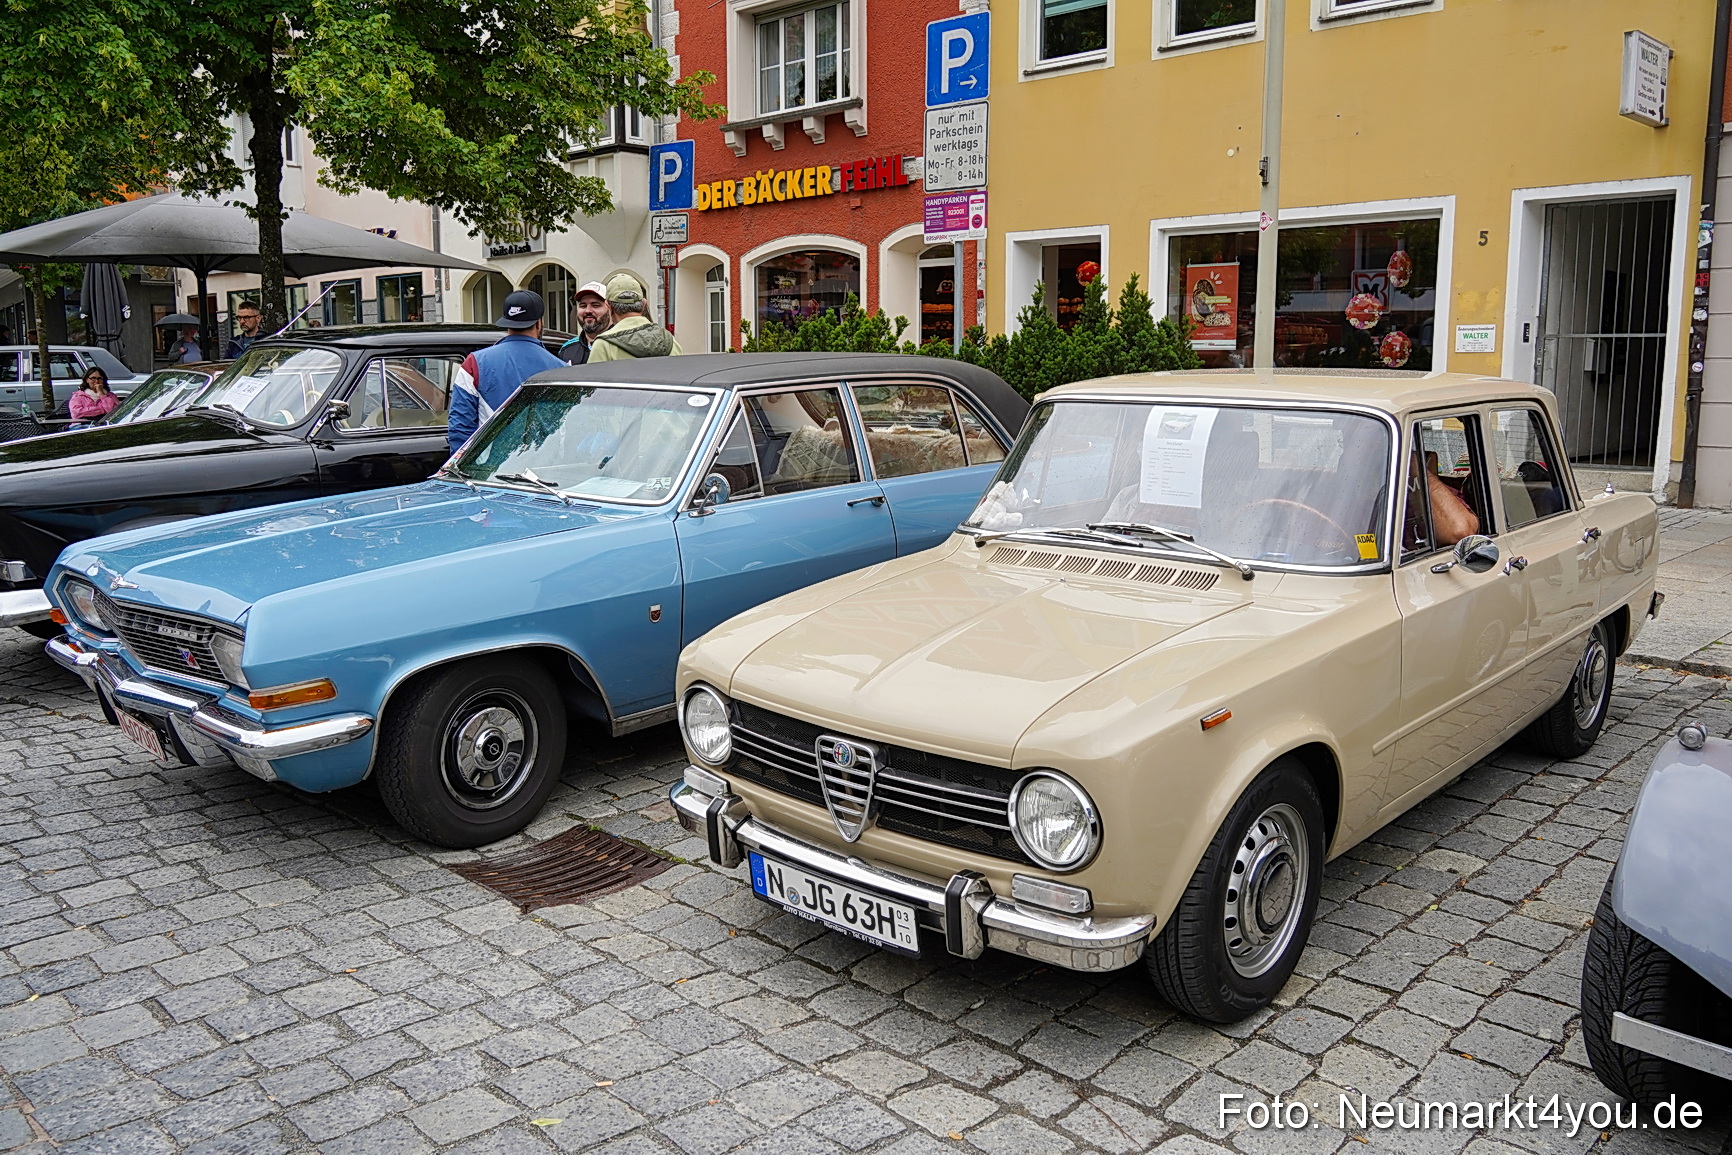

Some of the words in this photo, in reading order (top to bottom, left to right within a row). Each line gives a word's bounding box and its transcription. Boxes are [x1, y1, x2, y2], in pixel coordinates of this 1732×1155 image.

[941, 28, 974, 94] P
[1641, 47, 1659, 67] WALTER
[938, 113, 954, 125] nur
[958, 110, 974, 122] mit
[930, 123, 982, 140] Parkschein
[934, 140, 978, 152] werktags
[659, 151, 682, 202] P
[928, 174, 938, 184] Sa
[698, 180, 737, 211] DER
[743, 166, 834, 206] BÄCKER
[926, 196, 968, 206] HANDYPARKEN
[1478, 230, 1489, 246] 5
[490, 246, 508, 257] Nails
[514, 242, 531, 254] Lash
[1356, 534, 1374, 544] ADAC
[162, 627, 196, 638] OPEL
[757, 877, 763, 887] D
[767, 864, 785, 899] N
[802, 878, 836, 918] JG
[842, 892, 896, 940] 63H
[782, 904, 798, 916] AUTO
[824, 920, 848, 936] Nürnberg
[896, 910, 909, 922] 03
[900, 932, 912, 944] 10
